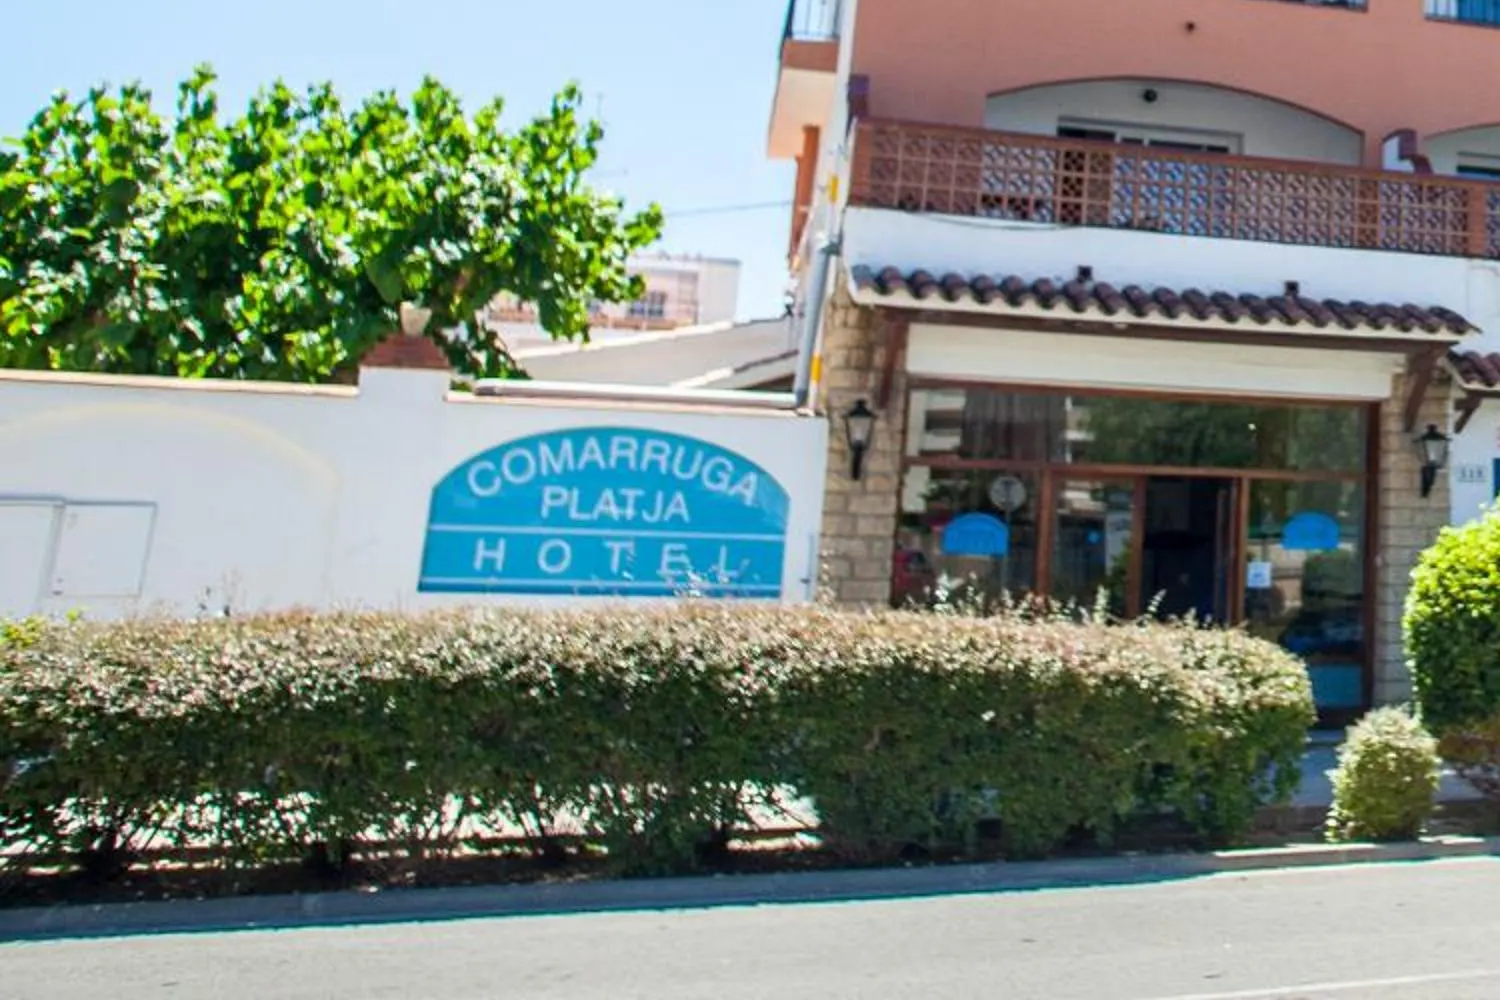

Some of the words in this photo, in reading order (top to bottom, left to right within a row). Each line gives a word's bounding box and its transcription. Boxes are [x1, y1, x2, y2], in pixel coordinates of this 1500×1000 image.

[467, 435, 758, 506] COMARRUGA
[540, 485, 691, 524] PLATJA
[473, 537, 739, 577] HOTEL
